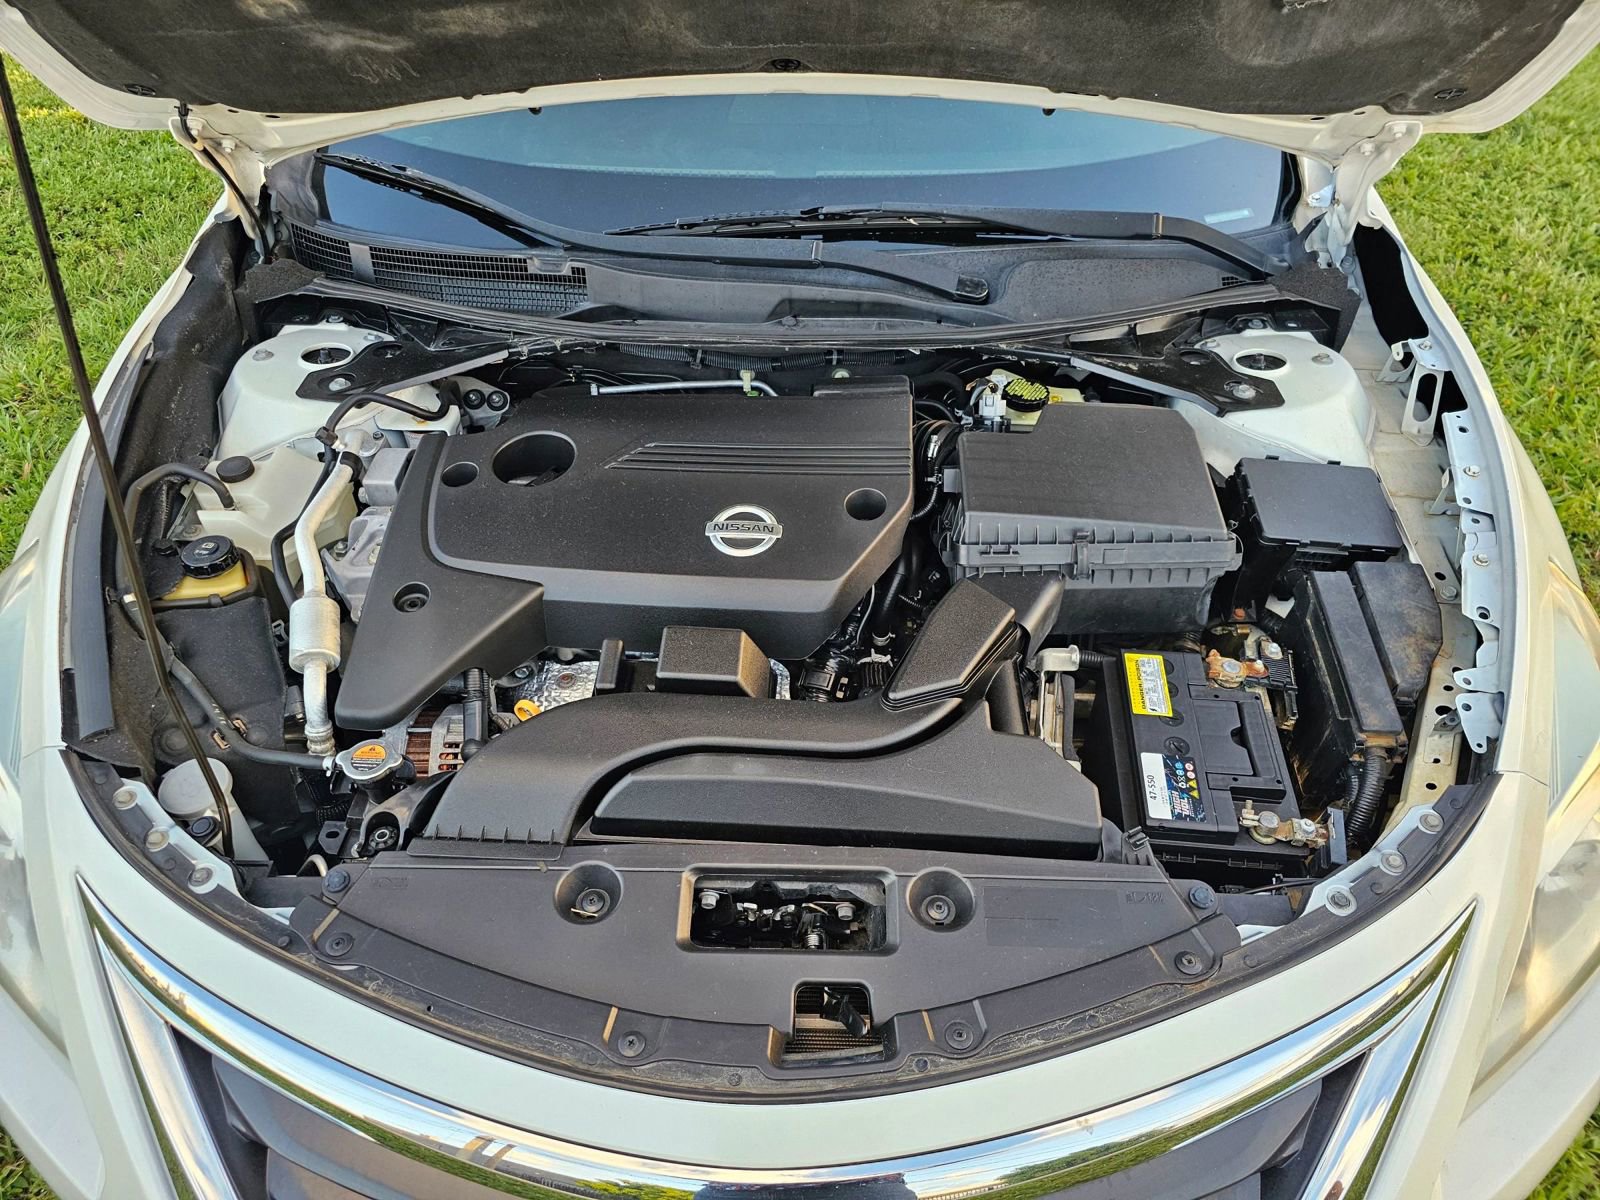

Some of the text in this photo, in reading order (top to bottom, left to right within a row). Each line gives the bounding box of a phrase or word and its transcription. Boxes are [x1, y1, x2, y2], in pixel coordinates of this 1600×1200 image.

[713, 523, 775, 533] NISSAN
[1138, 683, 1147, 710] DANGER
[1146, 774, 1157, 801] 47-550
